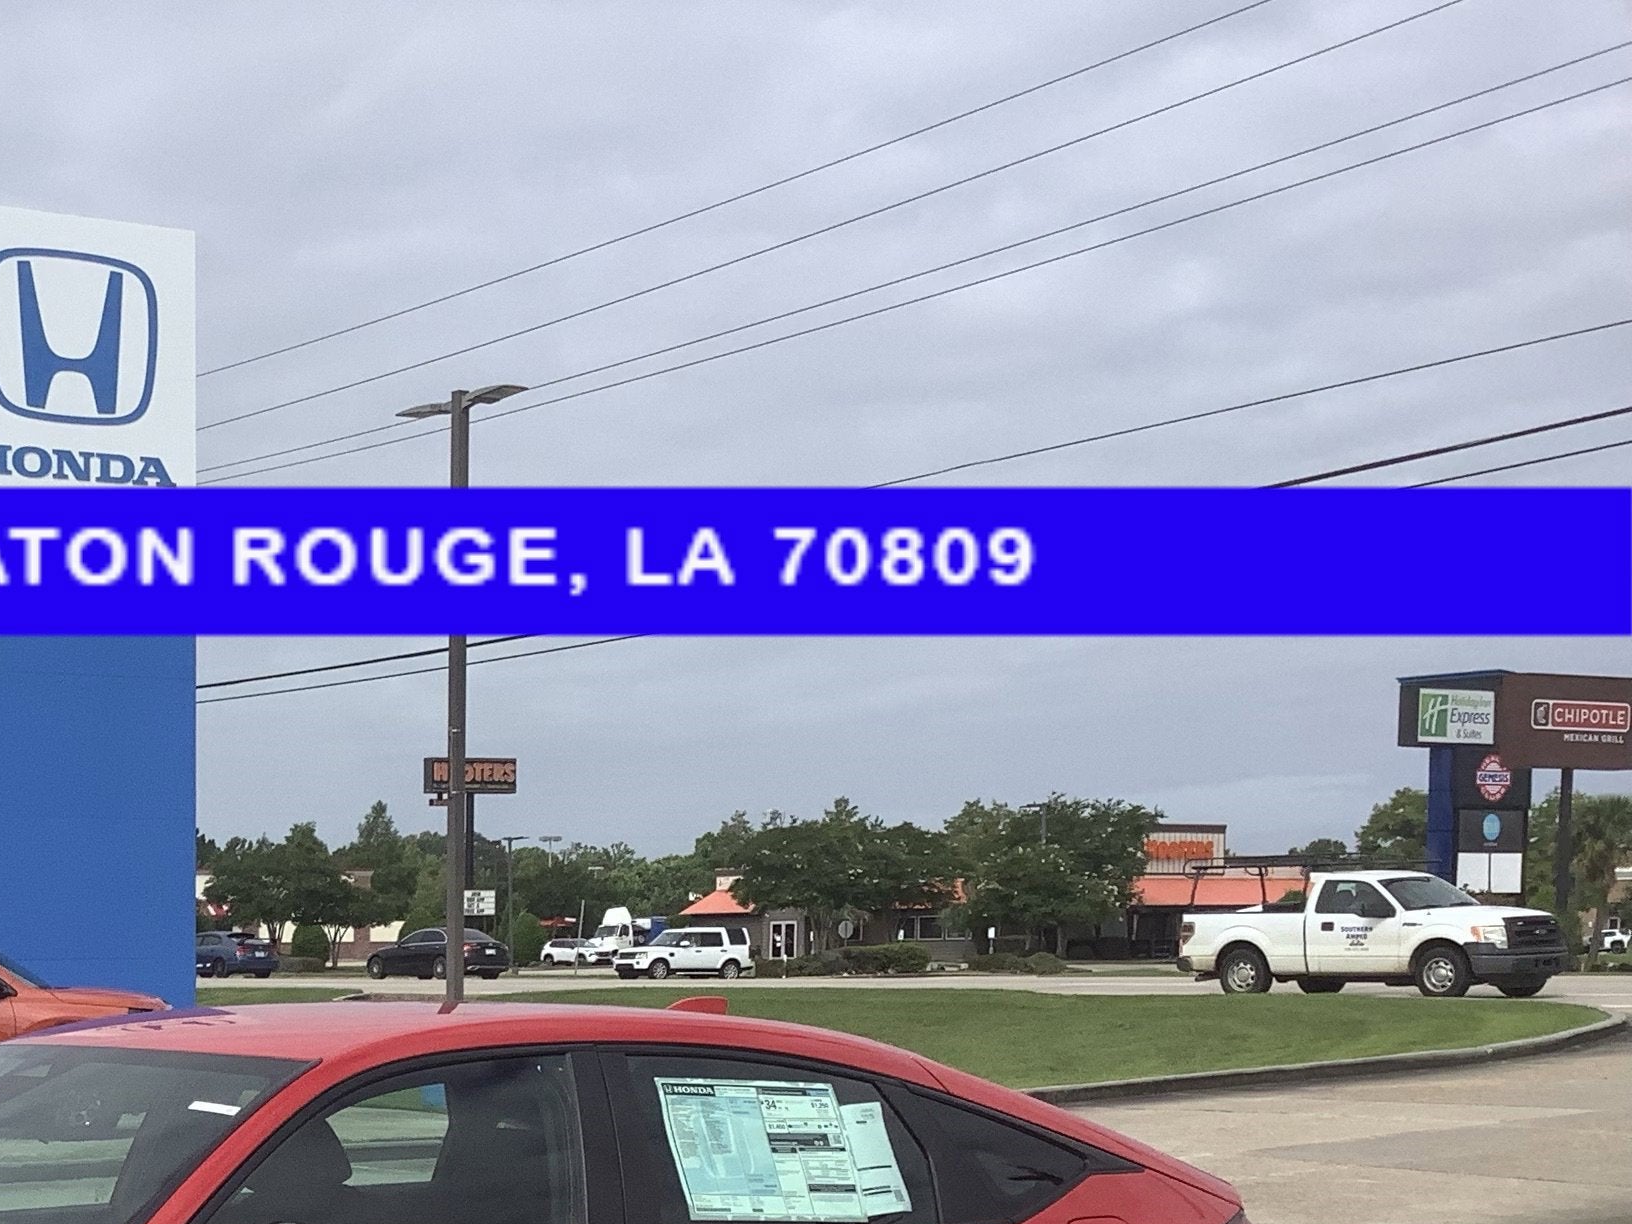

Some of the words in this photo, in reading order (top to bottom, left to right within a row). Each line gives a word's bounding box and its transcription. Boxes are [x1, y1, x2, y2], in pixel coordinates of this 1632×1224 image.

[1450, 708, 1490, 725] Express
[1554, 708, 1626, 725] CHIPOTLE
[1563, 734, 1599, 743] MEXICAN
[1601, 735, 1625, 744] GRILL
[433, 761, 515, 783] HOTERS
[673, 1086, 714, 1096] HONDA
[765, 1100, 777, 1110] 34
